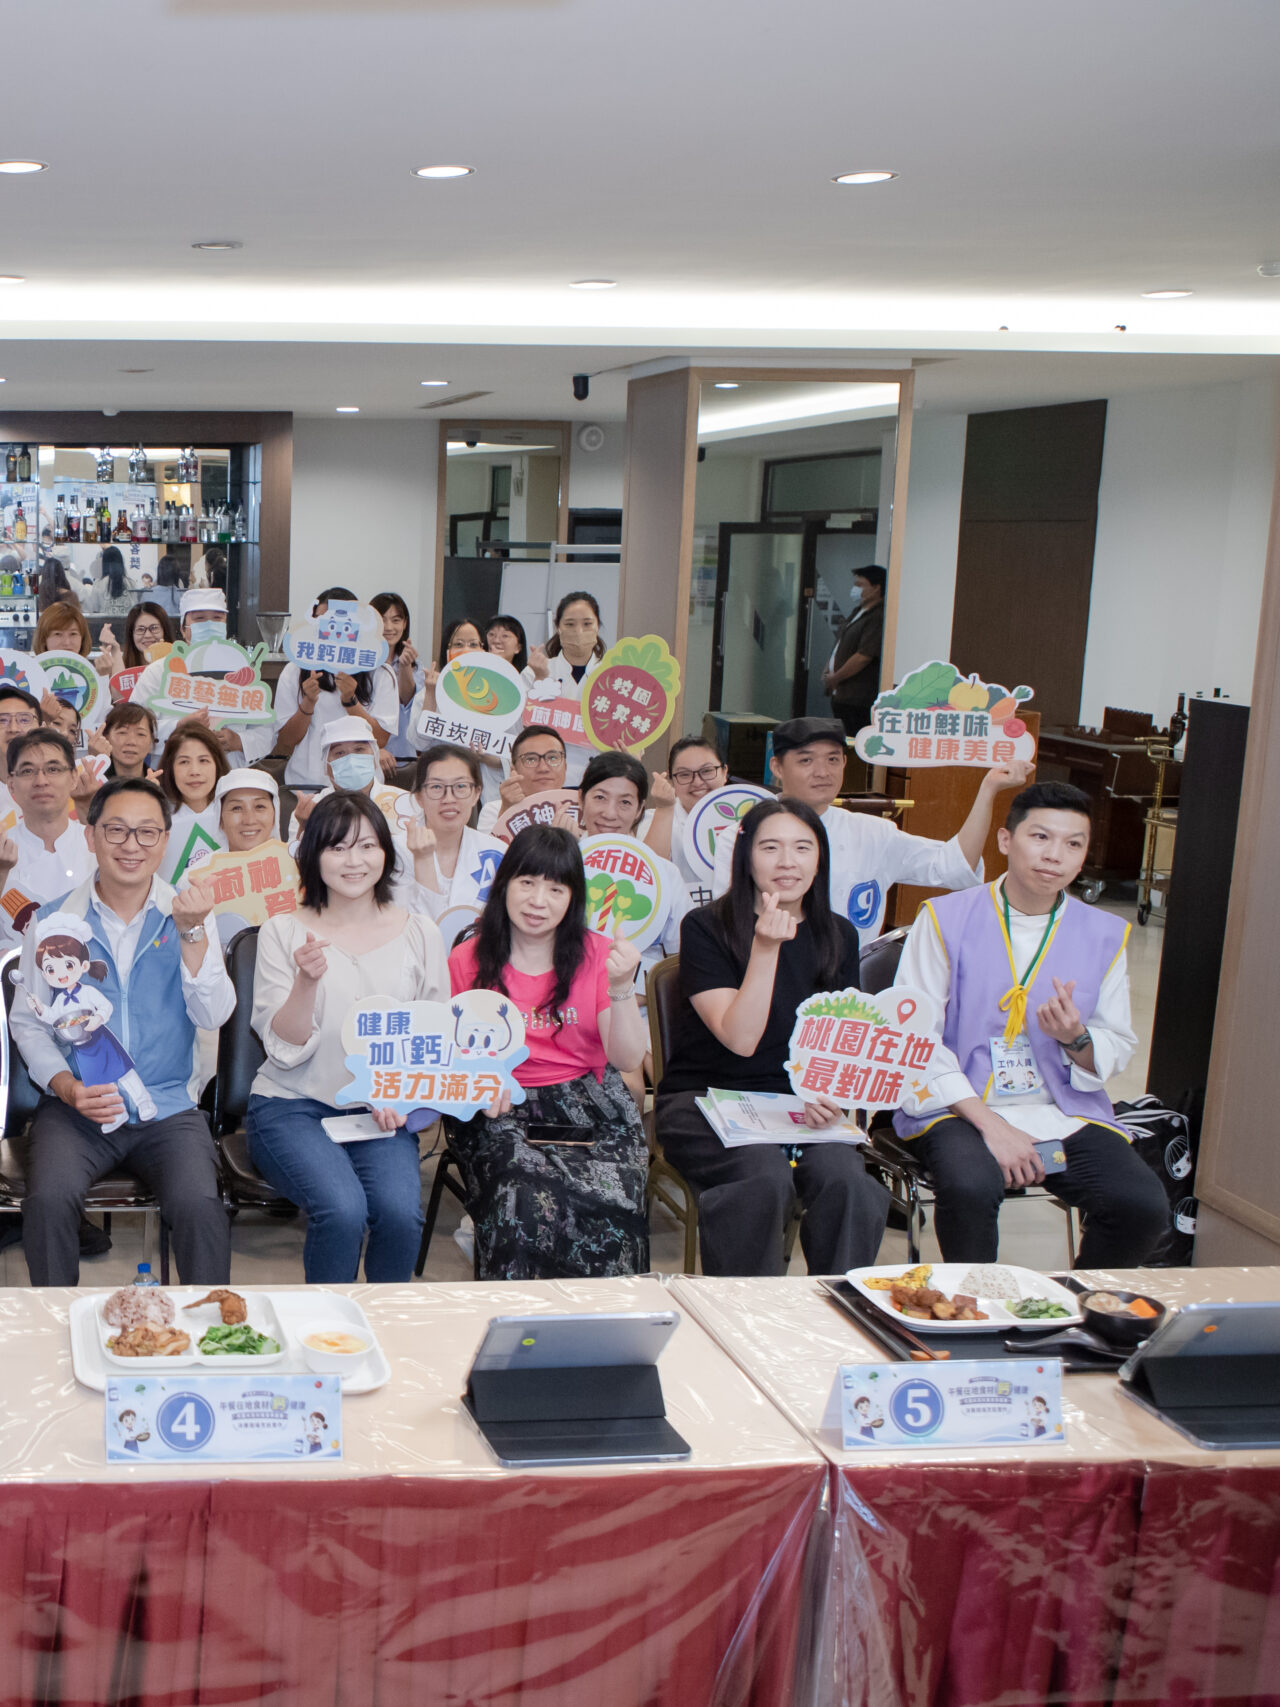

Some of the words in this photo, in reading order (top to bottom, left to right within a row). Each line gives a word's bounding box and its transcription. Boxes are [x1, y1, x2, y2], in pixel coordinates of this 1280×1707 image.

[296, 641, 377, 668] 我鈣厲害
[168, 675, 264, 712] 廚藝無限
[612, 677, 652, 706] 校園
[592, 695, 651, 734] 米其林
[878, 710, 990, 738] 在地鮮味
[424, 715, 513, 755] 南崁國小
[908, 737, 1016, 763] 健康美食
[583, 848, 654, 886] 新明
[857, 885, 875, 921] 9
[356, 1011, 411, 1037] 健康
[796, 1016, 936, 1071] 桃園在地
[370, 1070, 502, 1103] 活力滿分
[800, 1056, 905, 1104] 最對味
[170, 1401, 201, 1441] 4
[904, 1388, 931, 1427] 5
